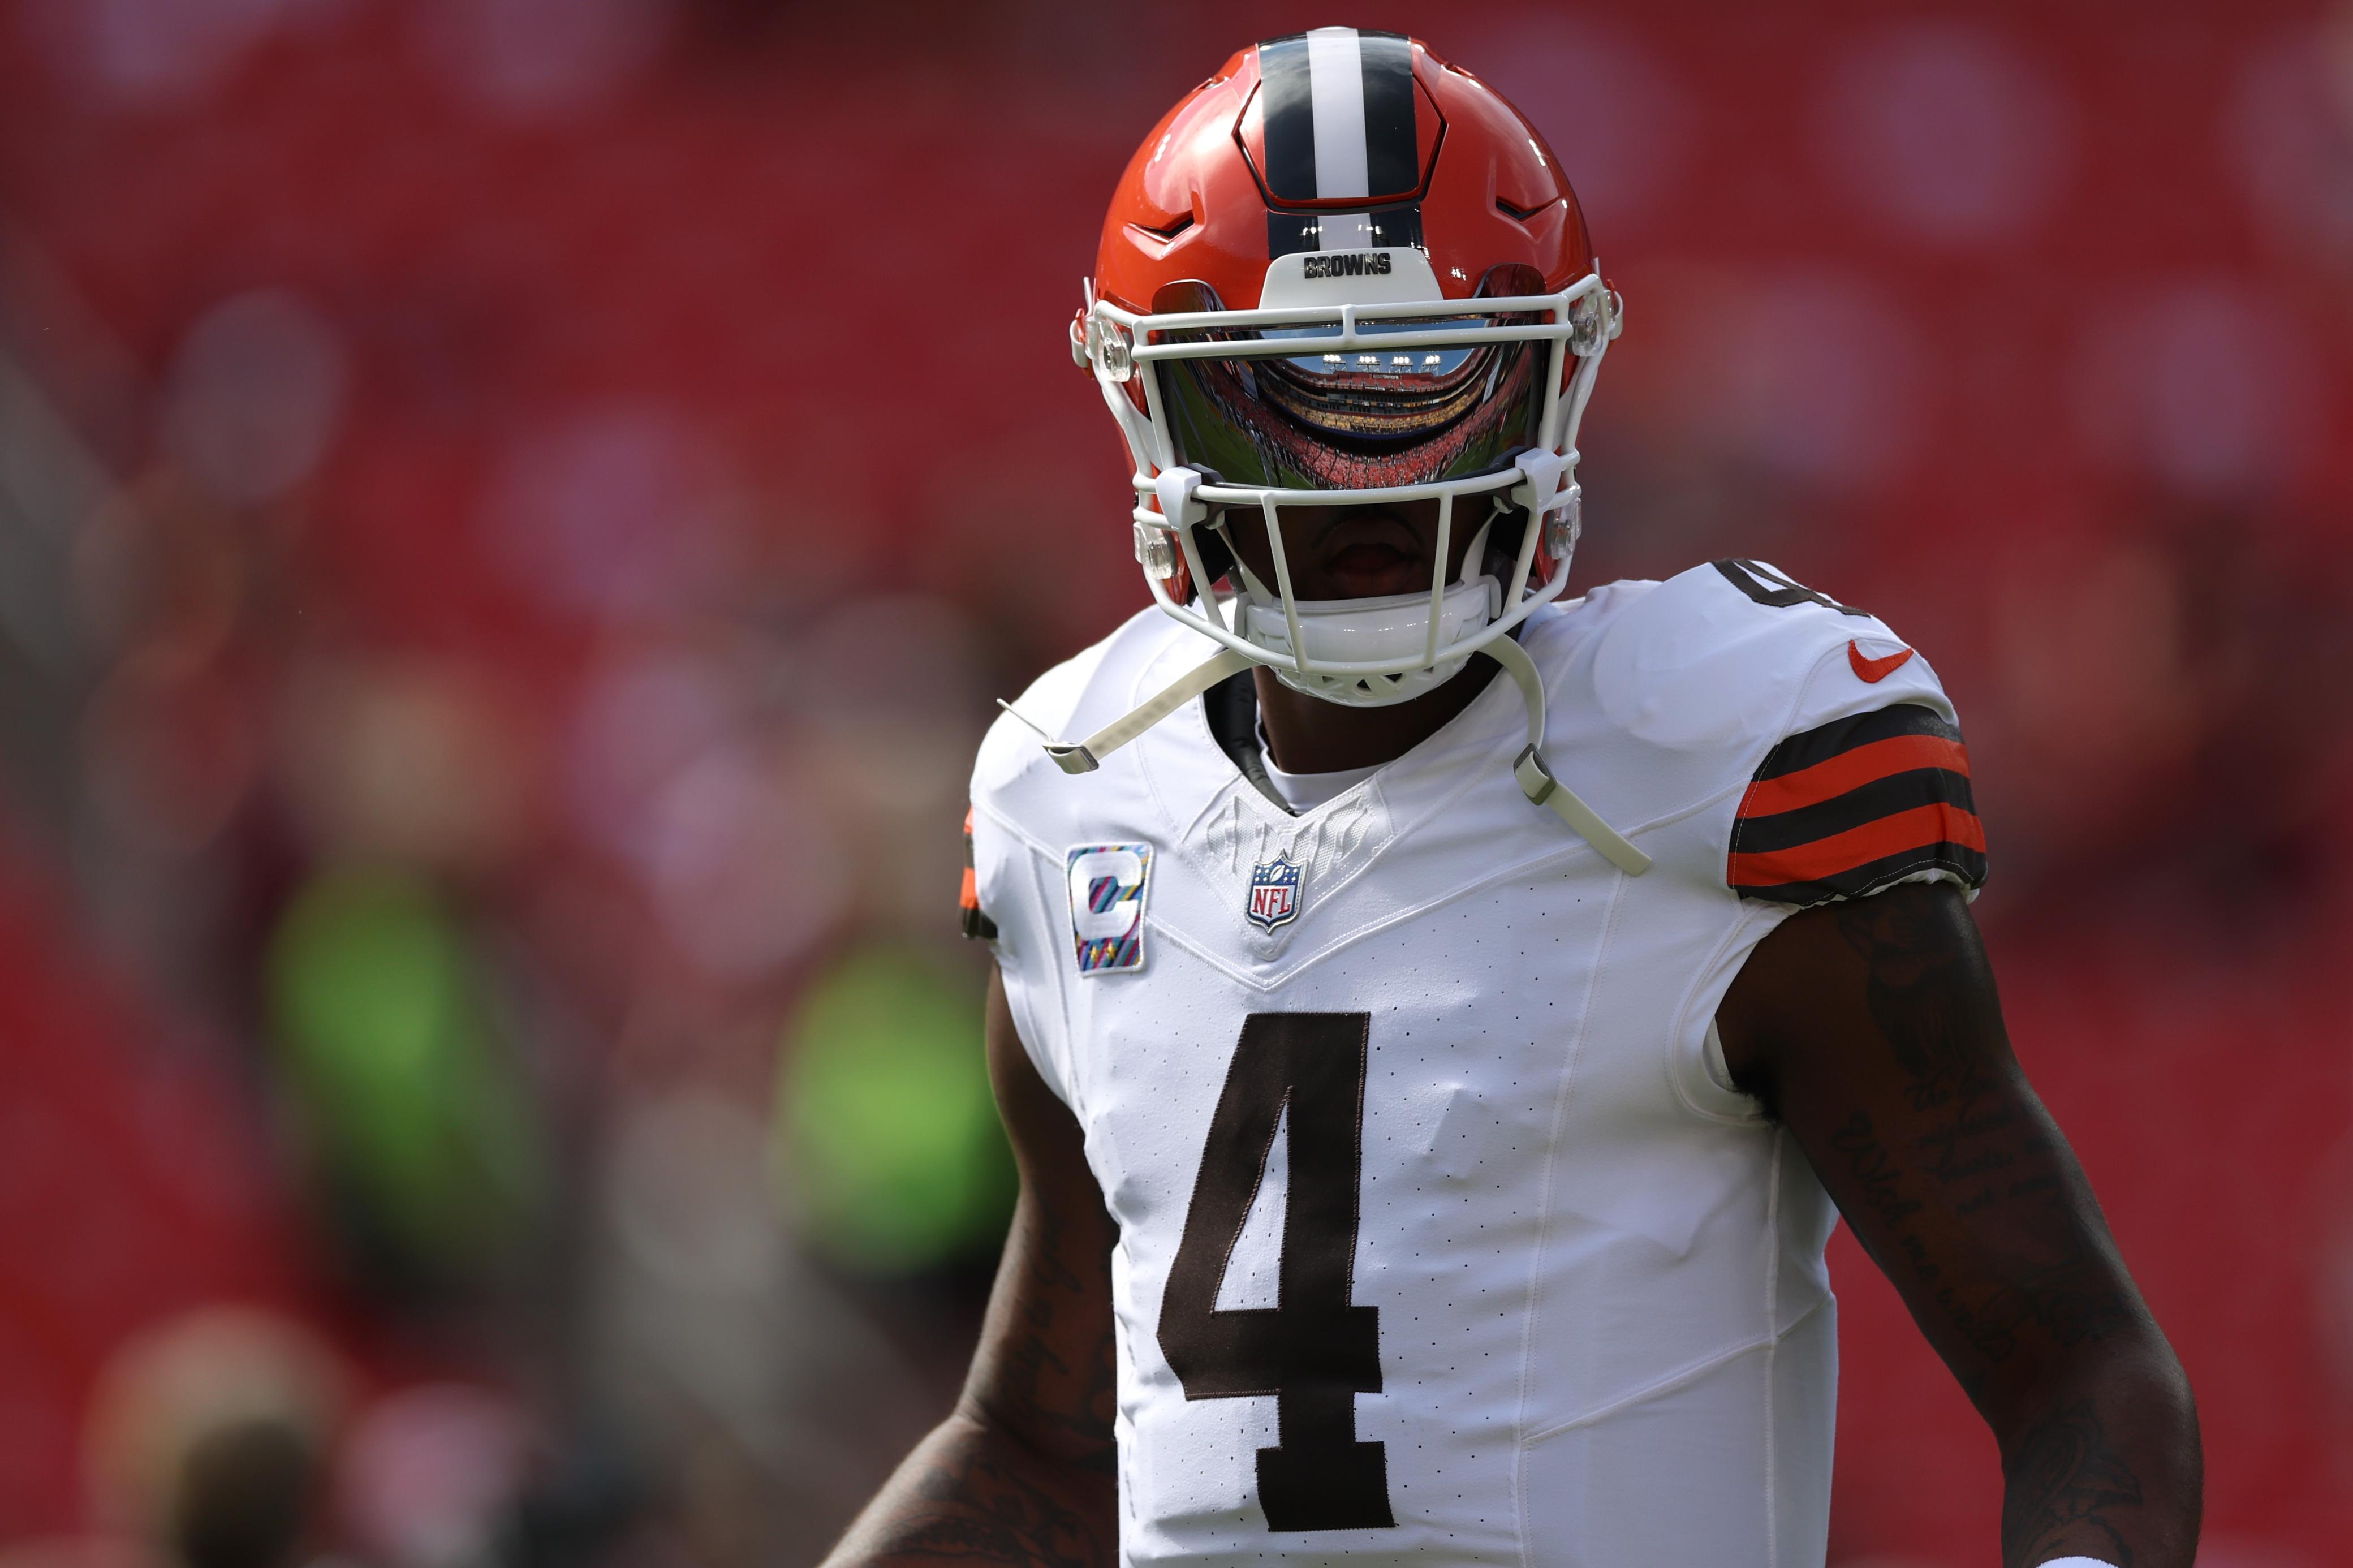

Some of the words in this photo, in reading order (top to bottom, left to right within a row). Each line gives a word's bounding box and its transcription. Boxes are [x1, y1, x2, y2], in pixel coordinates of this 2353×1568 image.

[1304, 253, 1391, 279] BROWNS
[1070, 850, 1142, 940] C
[1252, 888, 1292, 917] NFL
[1156, 1011, 1397, 1532] 4
